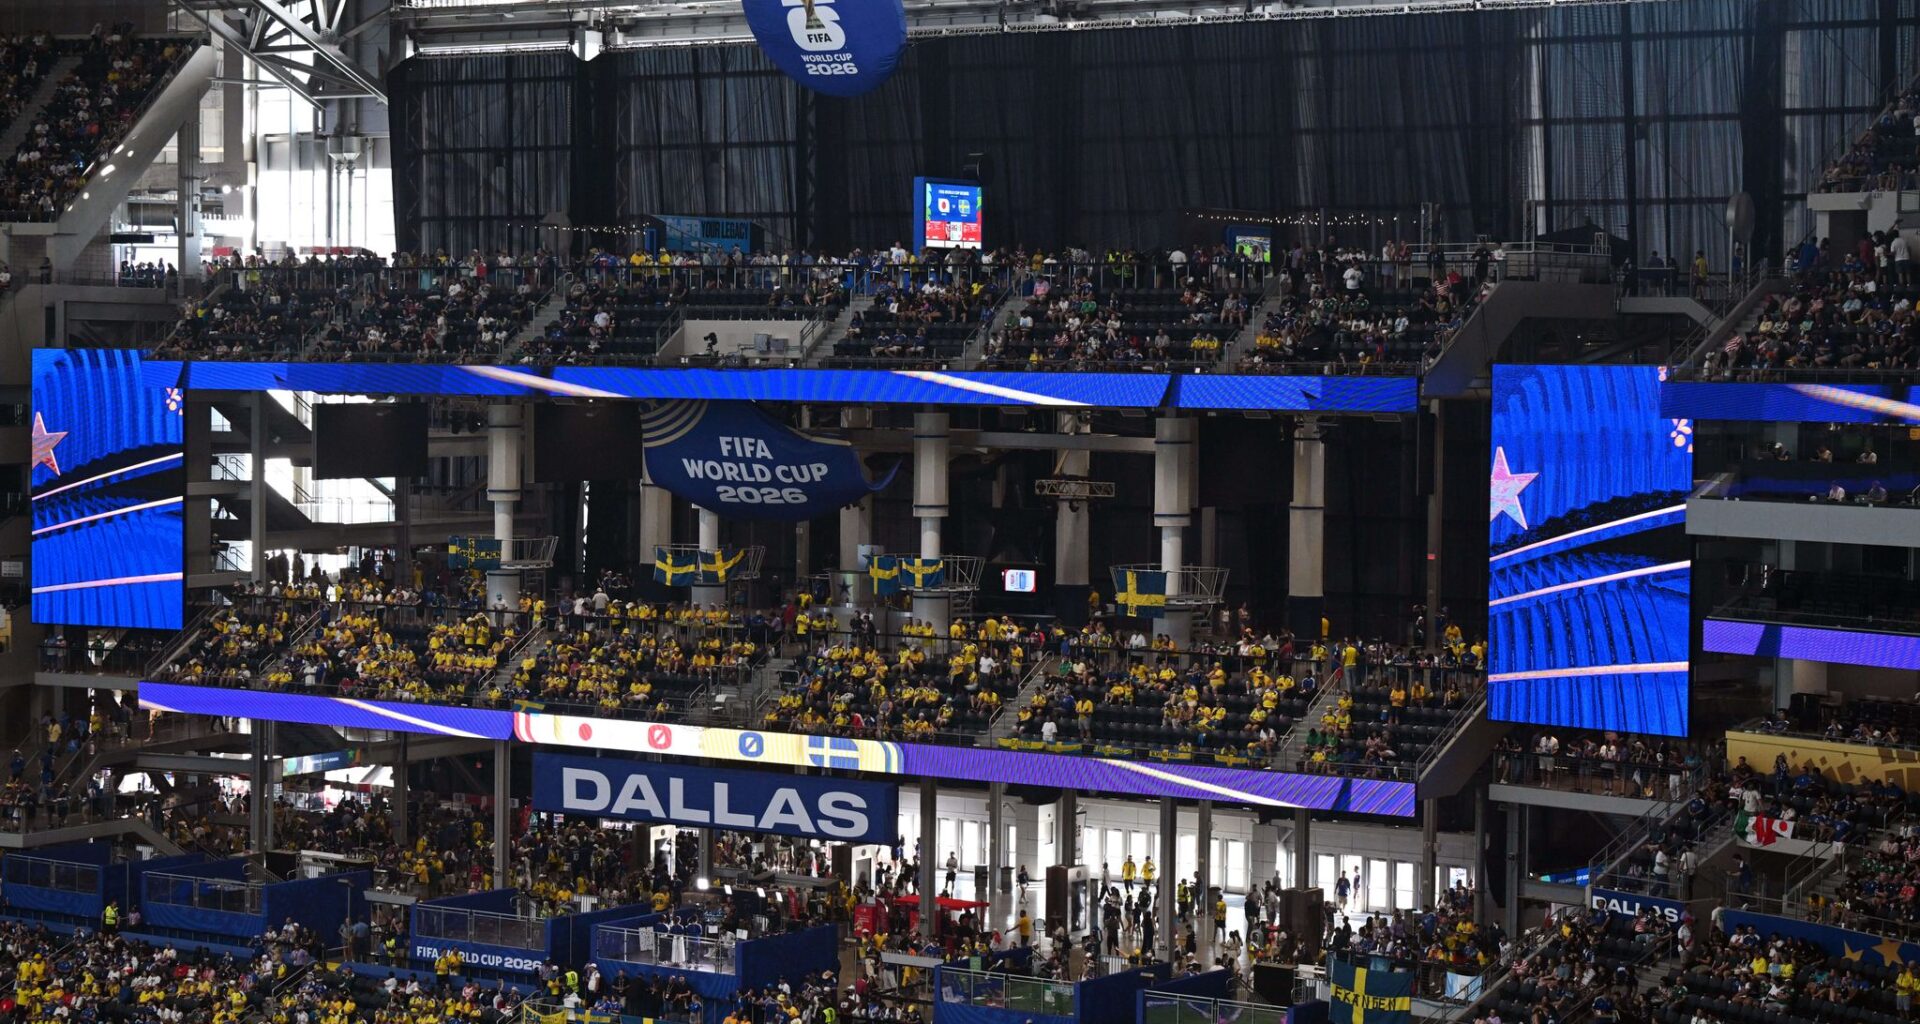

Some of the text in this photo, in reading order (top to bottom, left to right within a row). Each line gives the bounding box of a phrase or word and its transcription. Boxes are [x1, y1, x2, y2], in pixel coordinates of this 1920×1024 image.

[807, 33, 832, 43] FIFA
[801, 53, 853, 63] WORLD CUP
[805, 62, 858, 75] 2026
[701, 220, 720, 239] YOUR
[721, 221, 749, 240] LEGACY
[719, 436, 773, 460] FIFA
[682, 458, 828, 483] WORLD CUP
[716, 486, 808, 504] 2026
[562, 766, 869, 838] DALLAS
[1592, 895, 1679, 924] DALLS
[416, 945, 438, 958] FIFA
[480, 954, 503, 967] CUP
[504, 957, 543, 970] 2026
